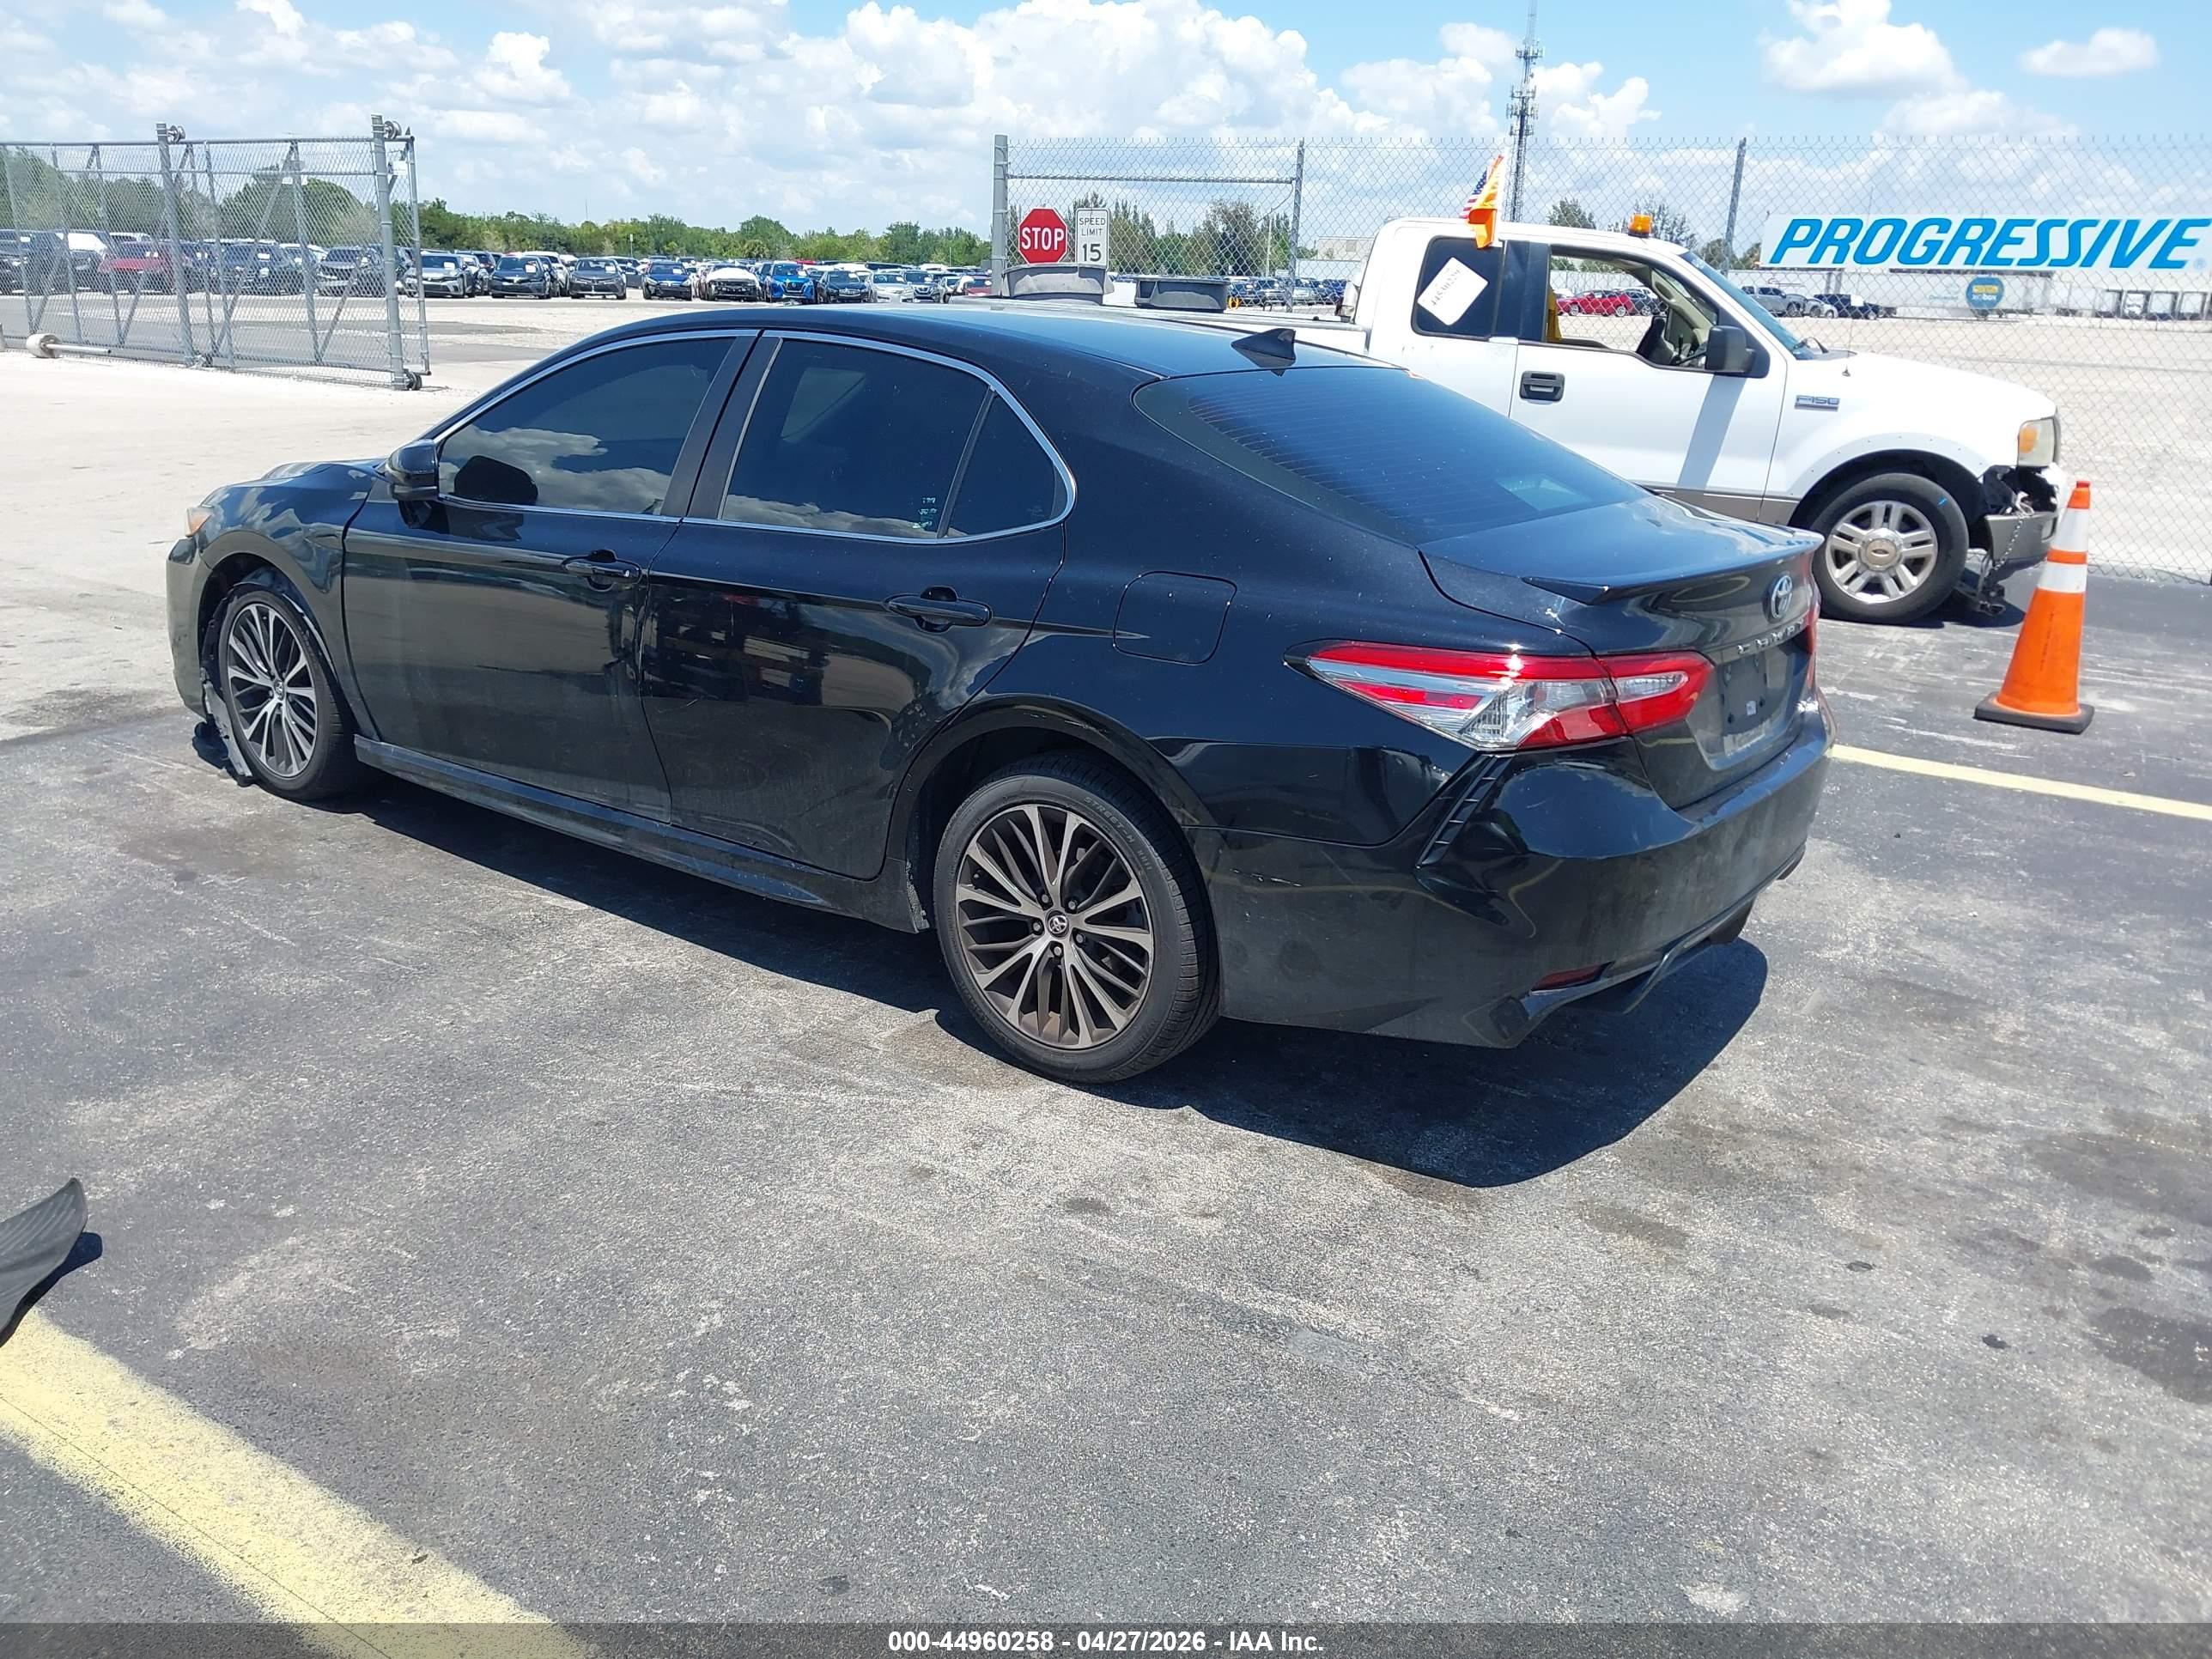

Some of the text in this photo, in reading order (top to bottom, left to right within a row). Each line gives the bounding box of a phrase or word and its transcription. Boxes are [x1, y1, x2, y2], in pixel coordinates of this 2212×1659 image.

[1079, 217, 1106, 226] SPEED
[1021, 227, 1065, 251] STOP
[1081, 228, 1103, 236] LIMIT
[1083, 243, 1102, 262] 15
[1769, 218, 2211, 270] PROGRESSIVE
